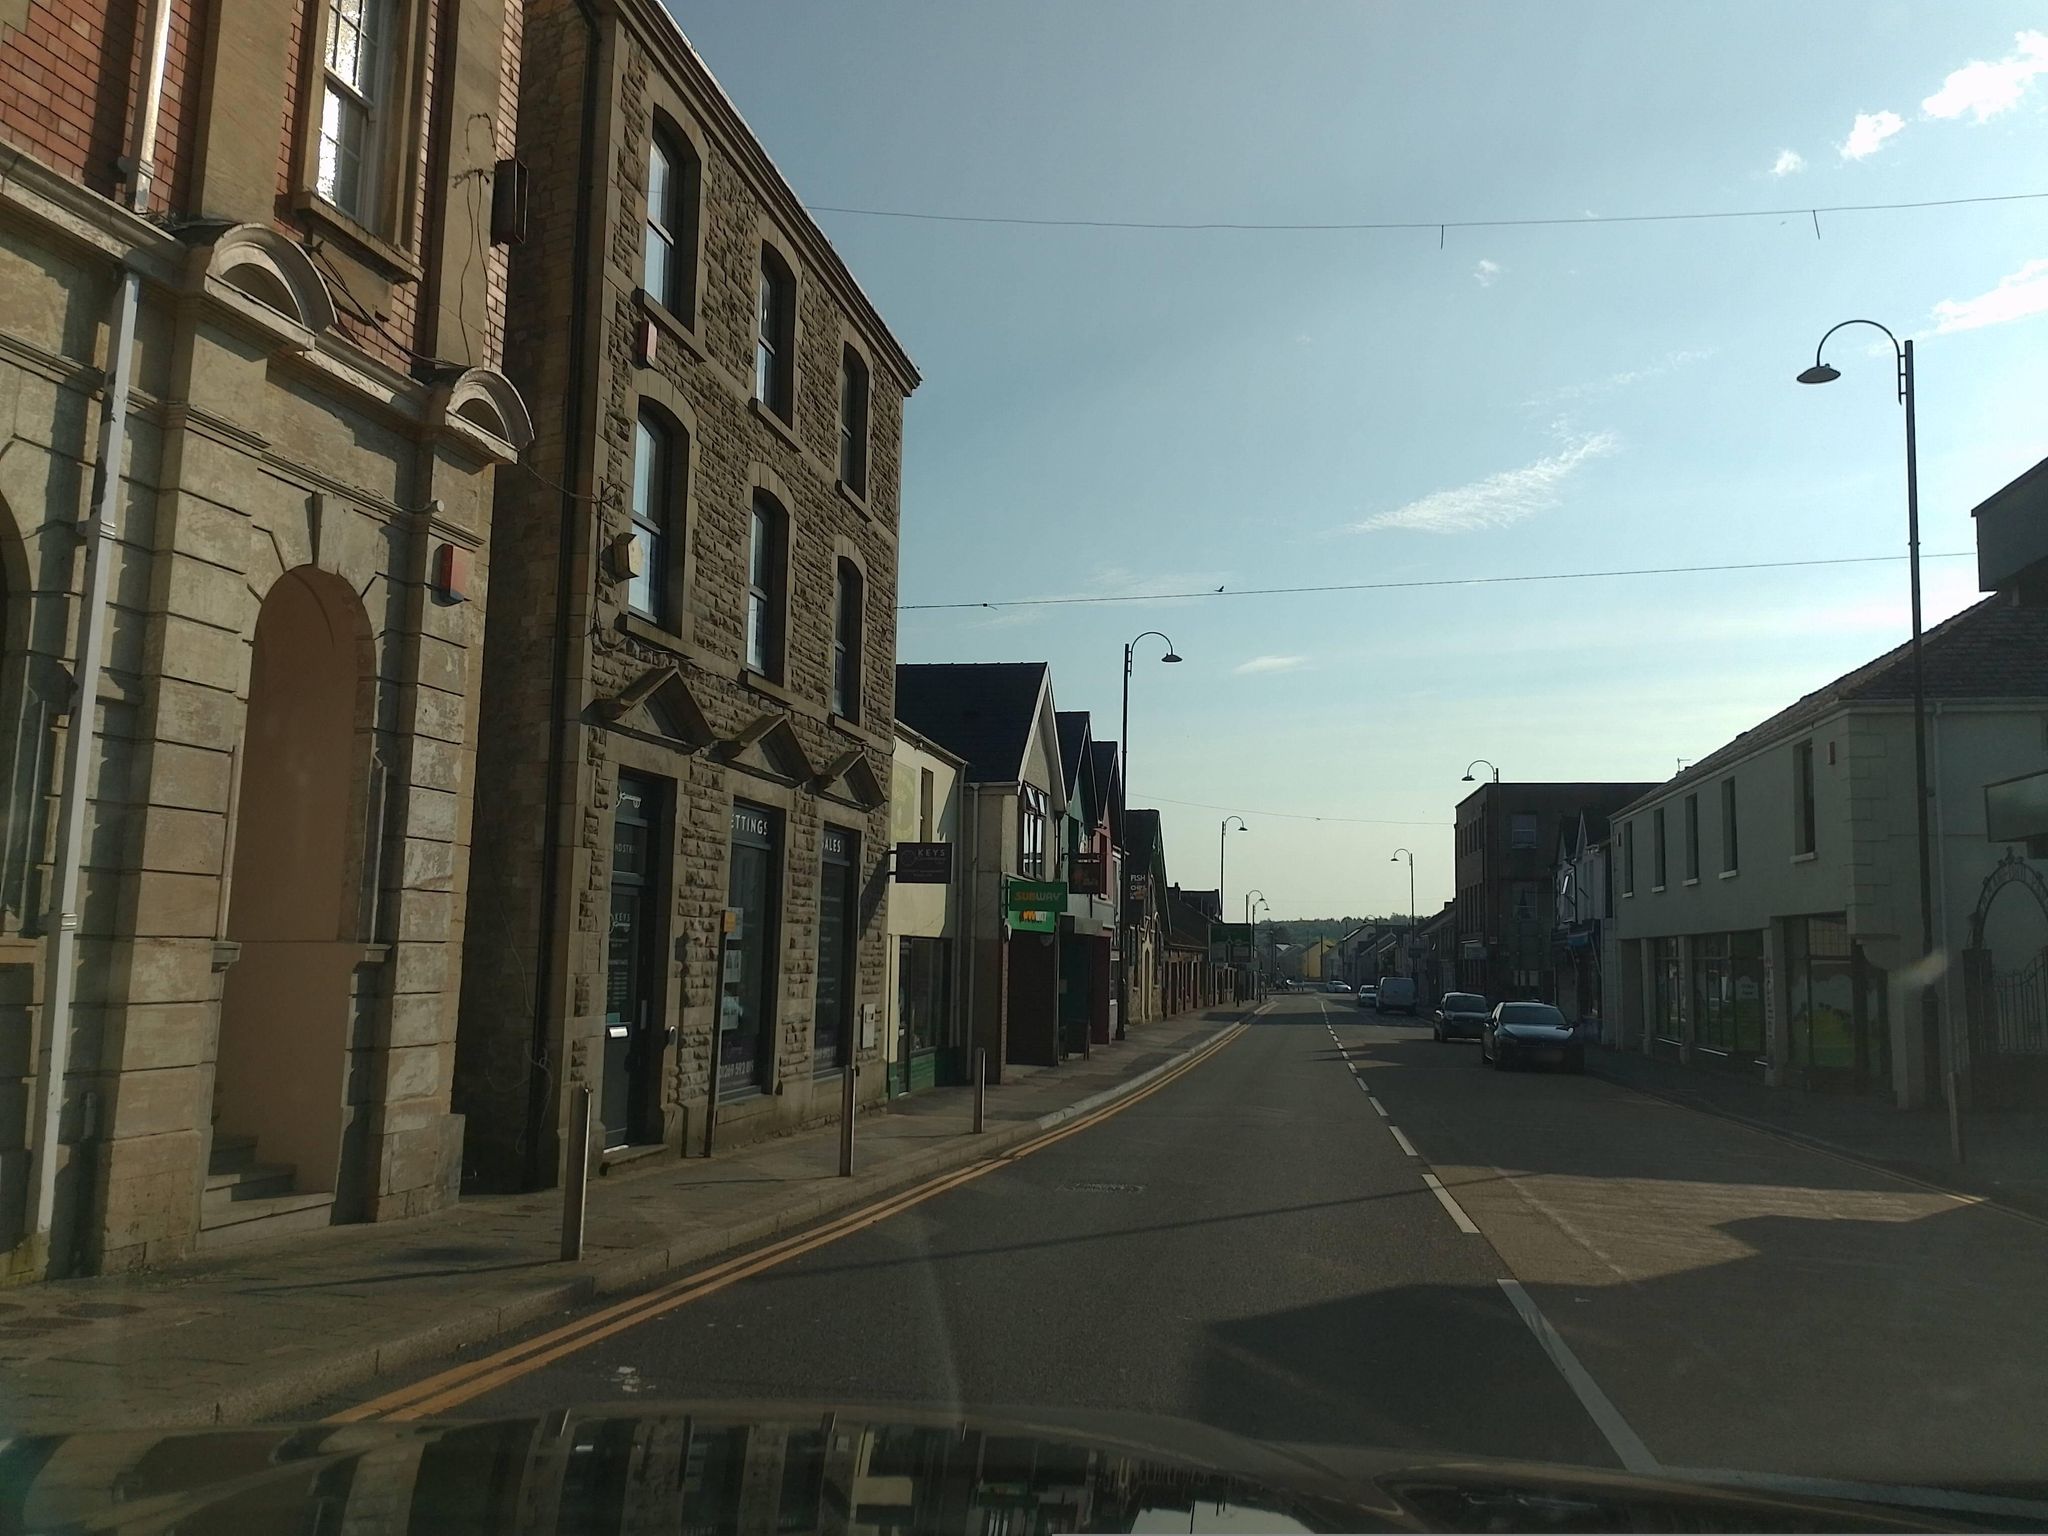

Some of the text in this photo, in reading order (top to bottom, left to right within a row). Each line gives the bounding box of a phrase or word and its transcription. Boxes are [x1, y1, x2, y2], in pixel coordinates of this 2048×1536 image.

[731, 813, 768, 836] ETTINGS
[821, 837, 842, 854] ALES
[917, 848, 945, 857] KEYS
[1130, 874, 1146, 882] FISH
[1013, 891, 1063, 902] SUBWAY
[615, 912, 630, 922] KEYS
